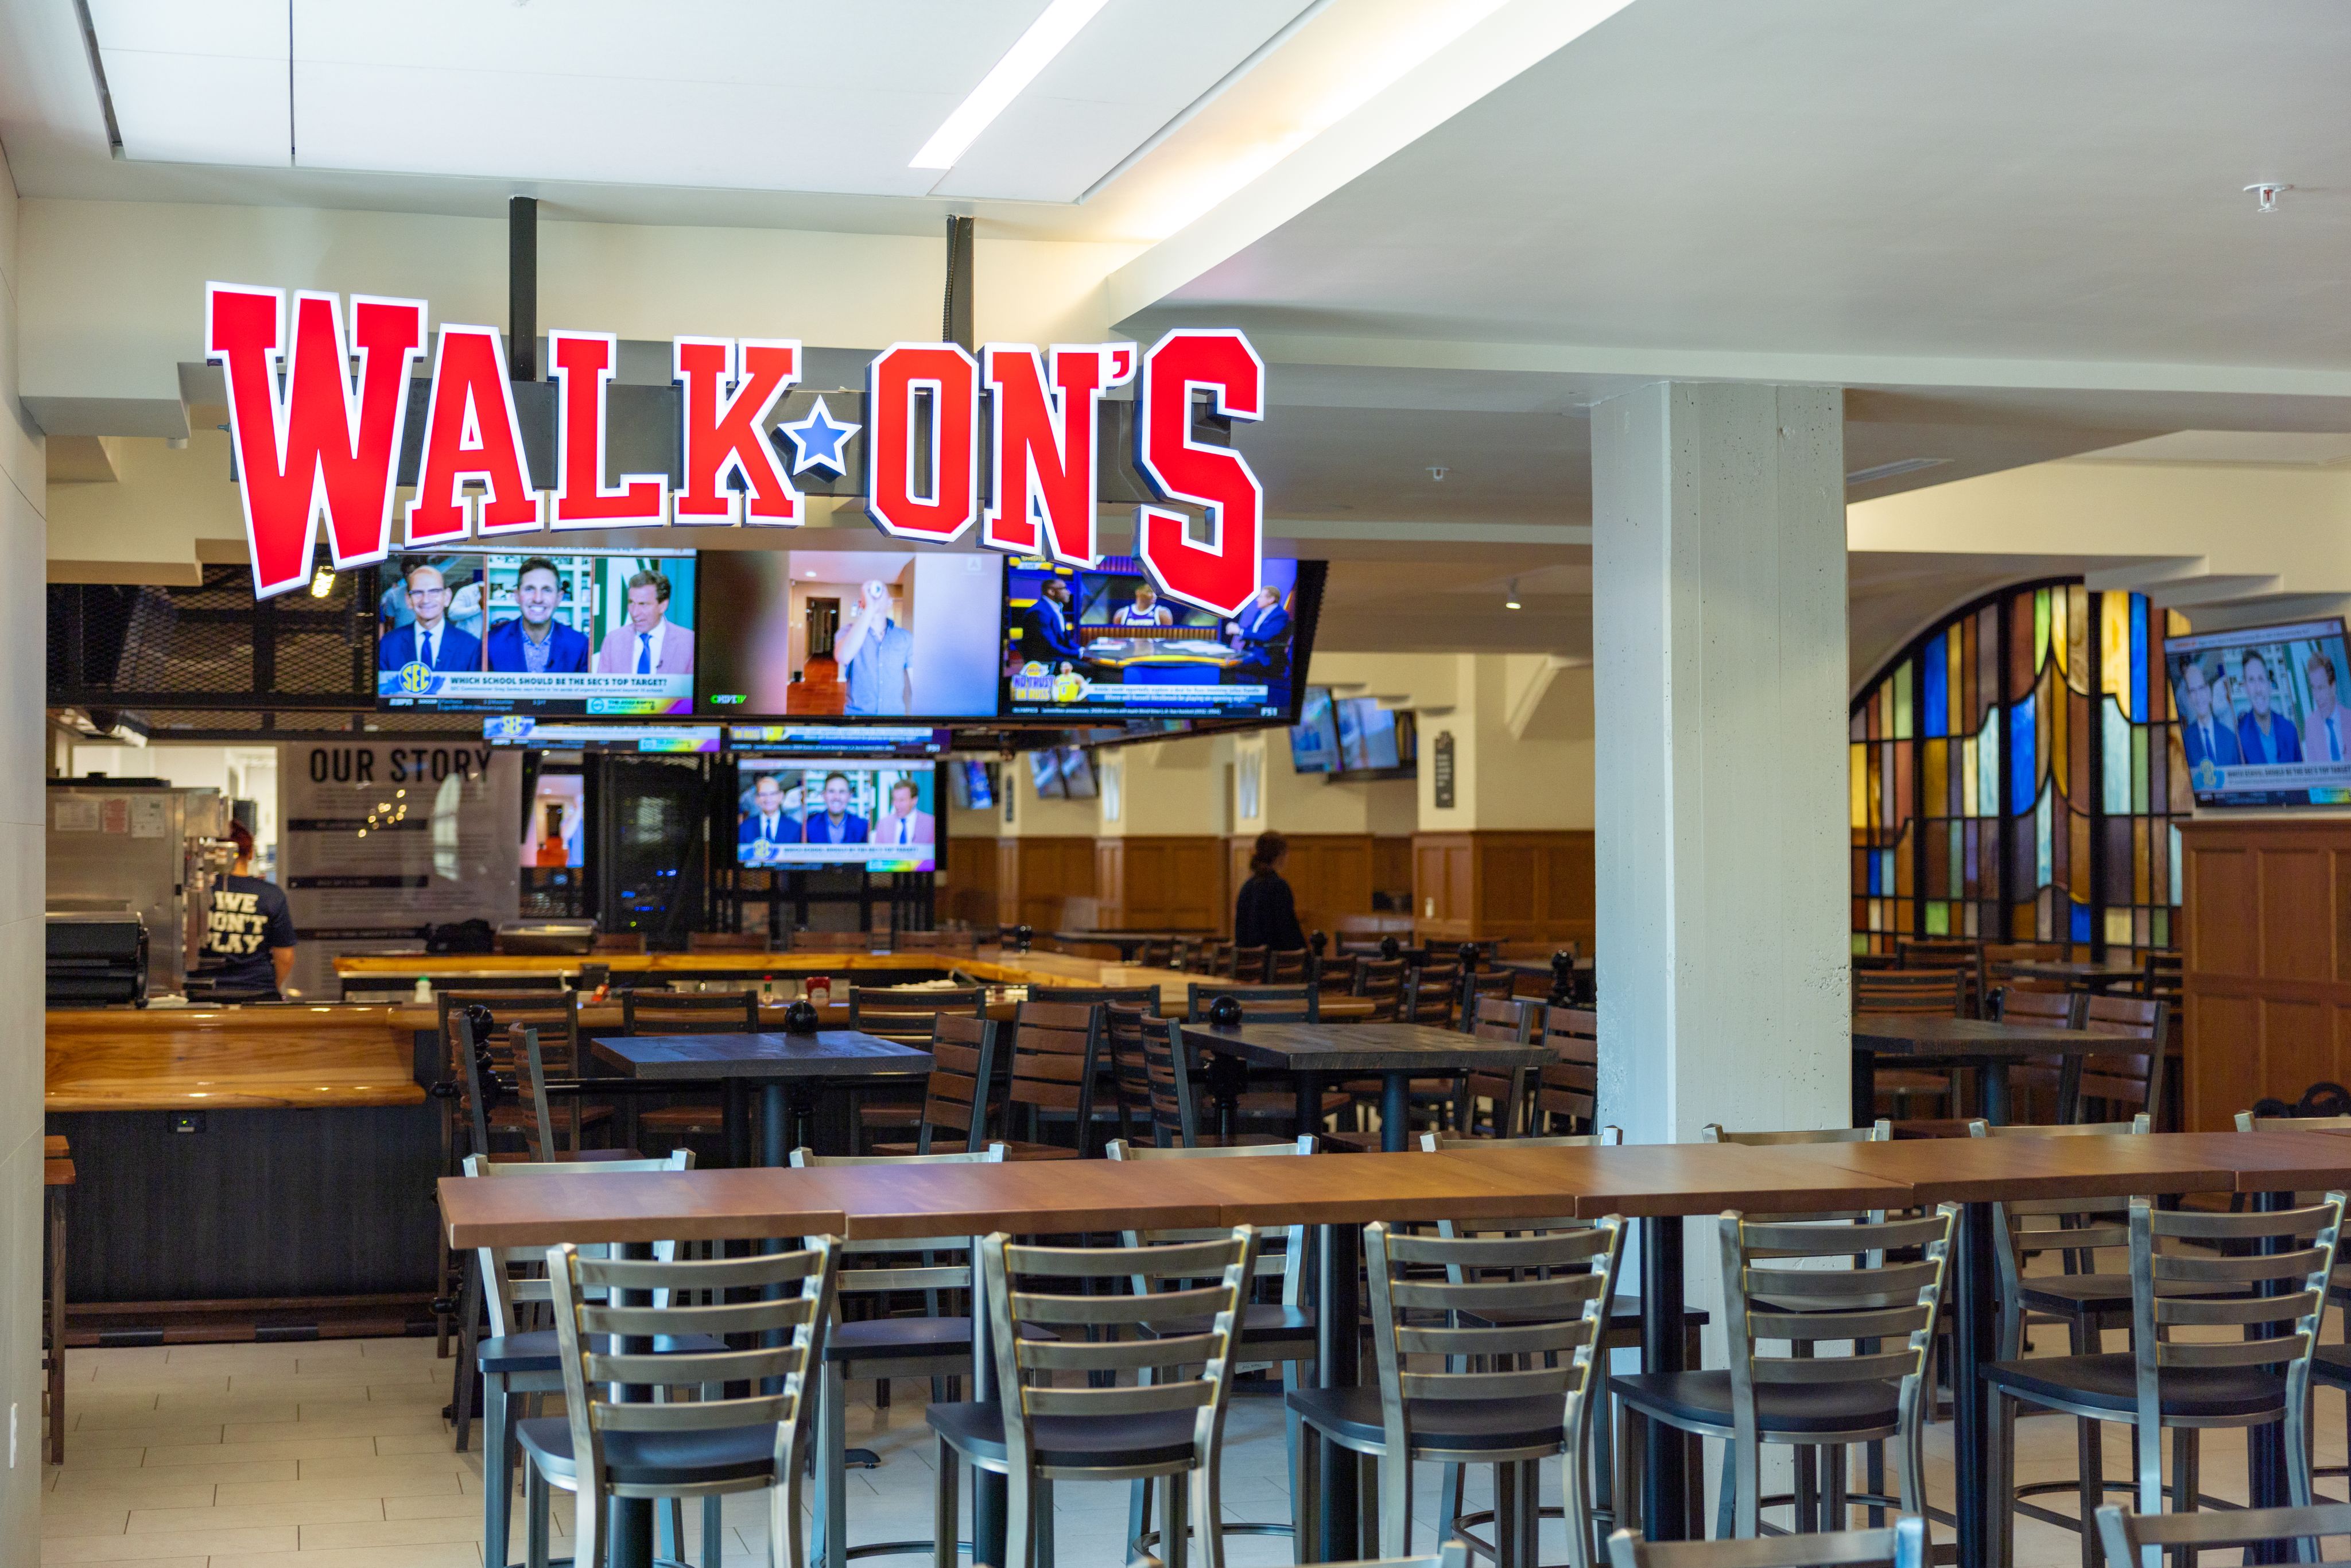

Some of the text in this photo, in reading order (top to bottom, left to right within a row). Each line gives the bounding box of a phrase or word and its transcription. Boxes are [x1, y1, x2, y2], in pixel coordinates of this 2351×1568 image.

[402, 664, 429, 692] SEC
[310, 748, 492, 783] OUR STORY
[214, 891, 259, 914] WE
